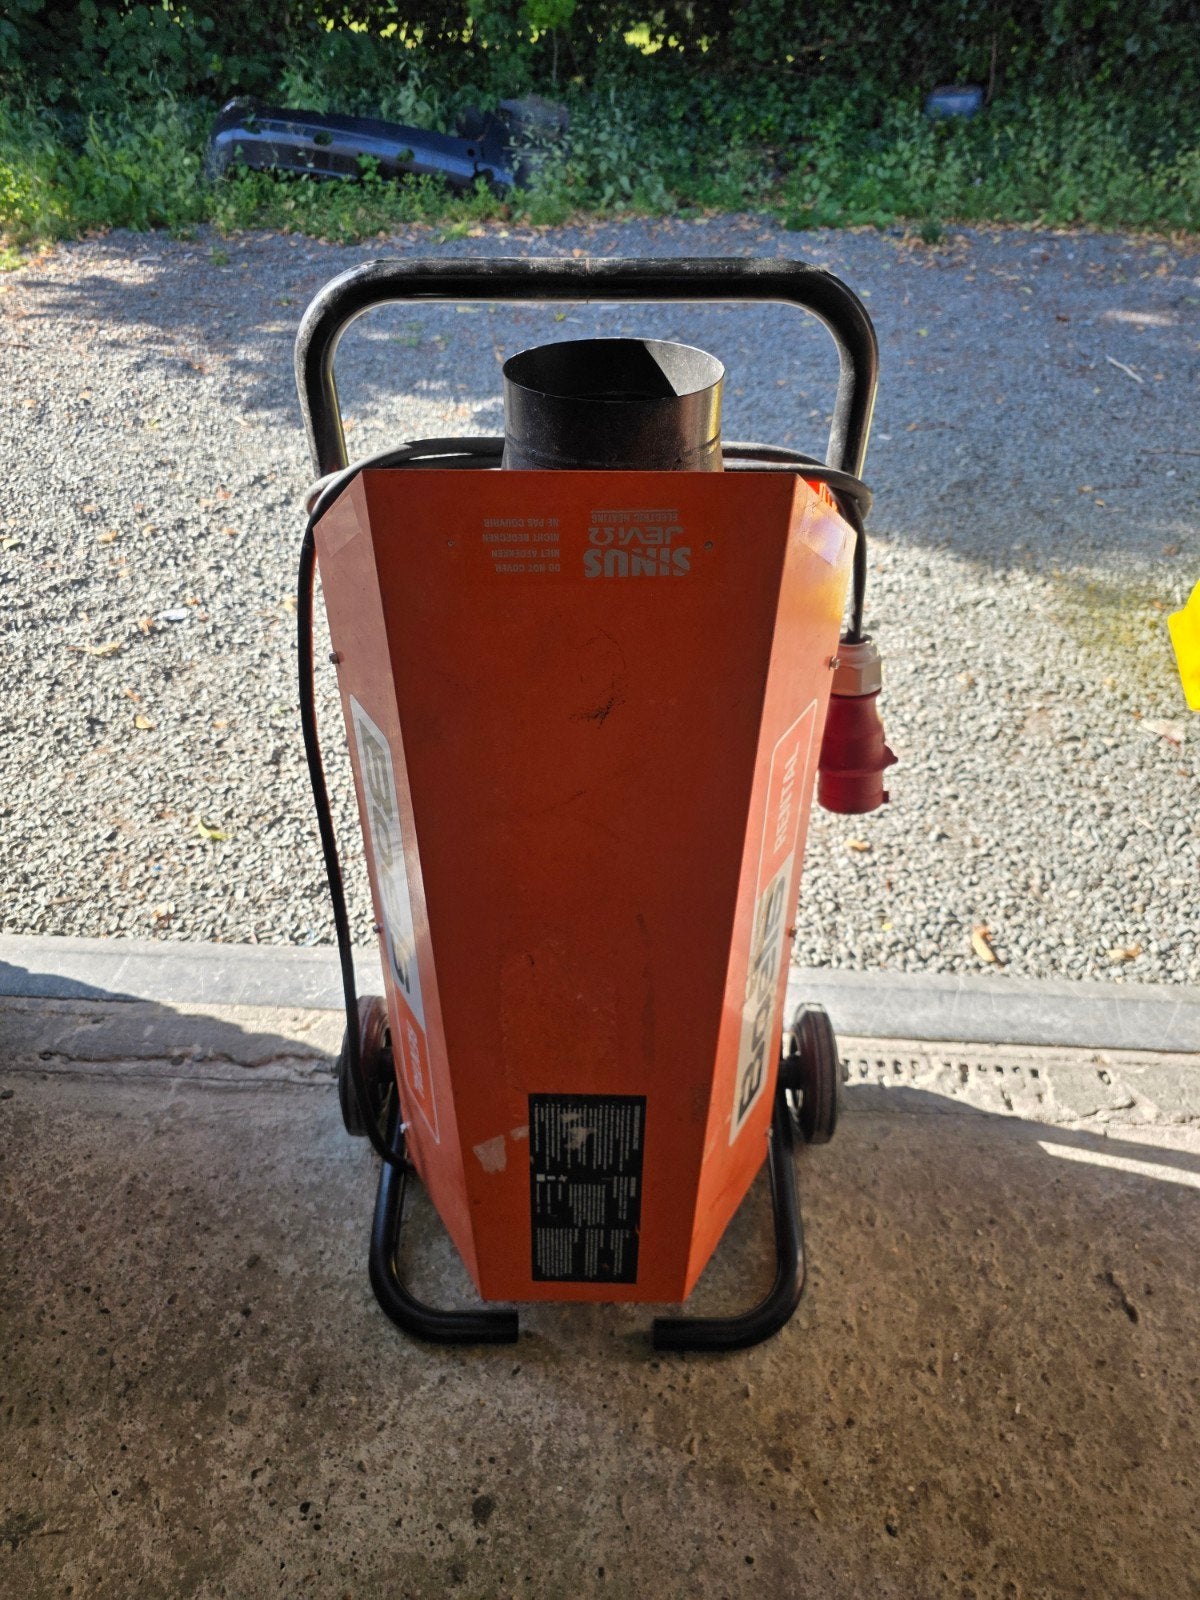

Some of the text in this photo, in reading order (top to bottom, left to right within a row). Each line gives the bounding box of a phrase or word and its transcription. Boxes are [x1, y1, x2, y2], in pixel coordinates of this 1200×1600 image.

[591, 512, 678, 523] ELECTRIC HEATING
[483, 518, 559, 528] NE PAS COUVRIR
[482, 533, 560, 543] NICHT BEDECKEN
[491, 549, 560, 558] NIET AFDEKKEN
[583, 547, 692, 578] SINUS
[495, 563, 561, 573] DO NOT COVER
[773, 741, 799, 854] RENTAL
[736, 876, 786, 1126] Boels
